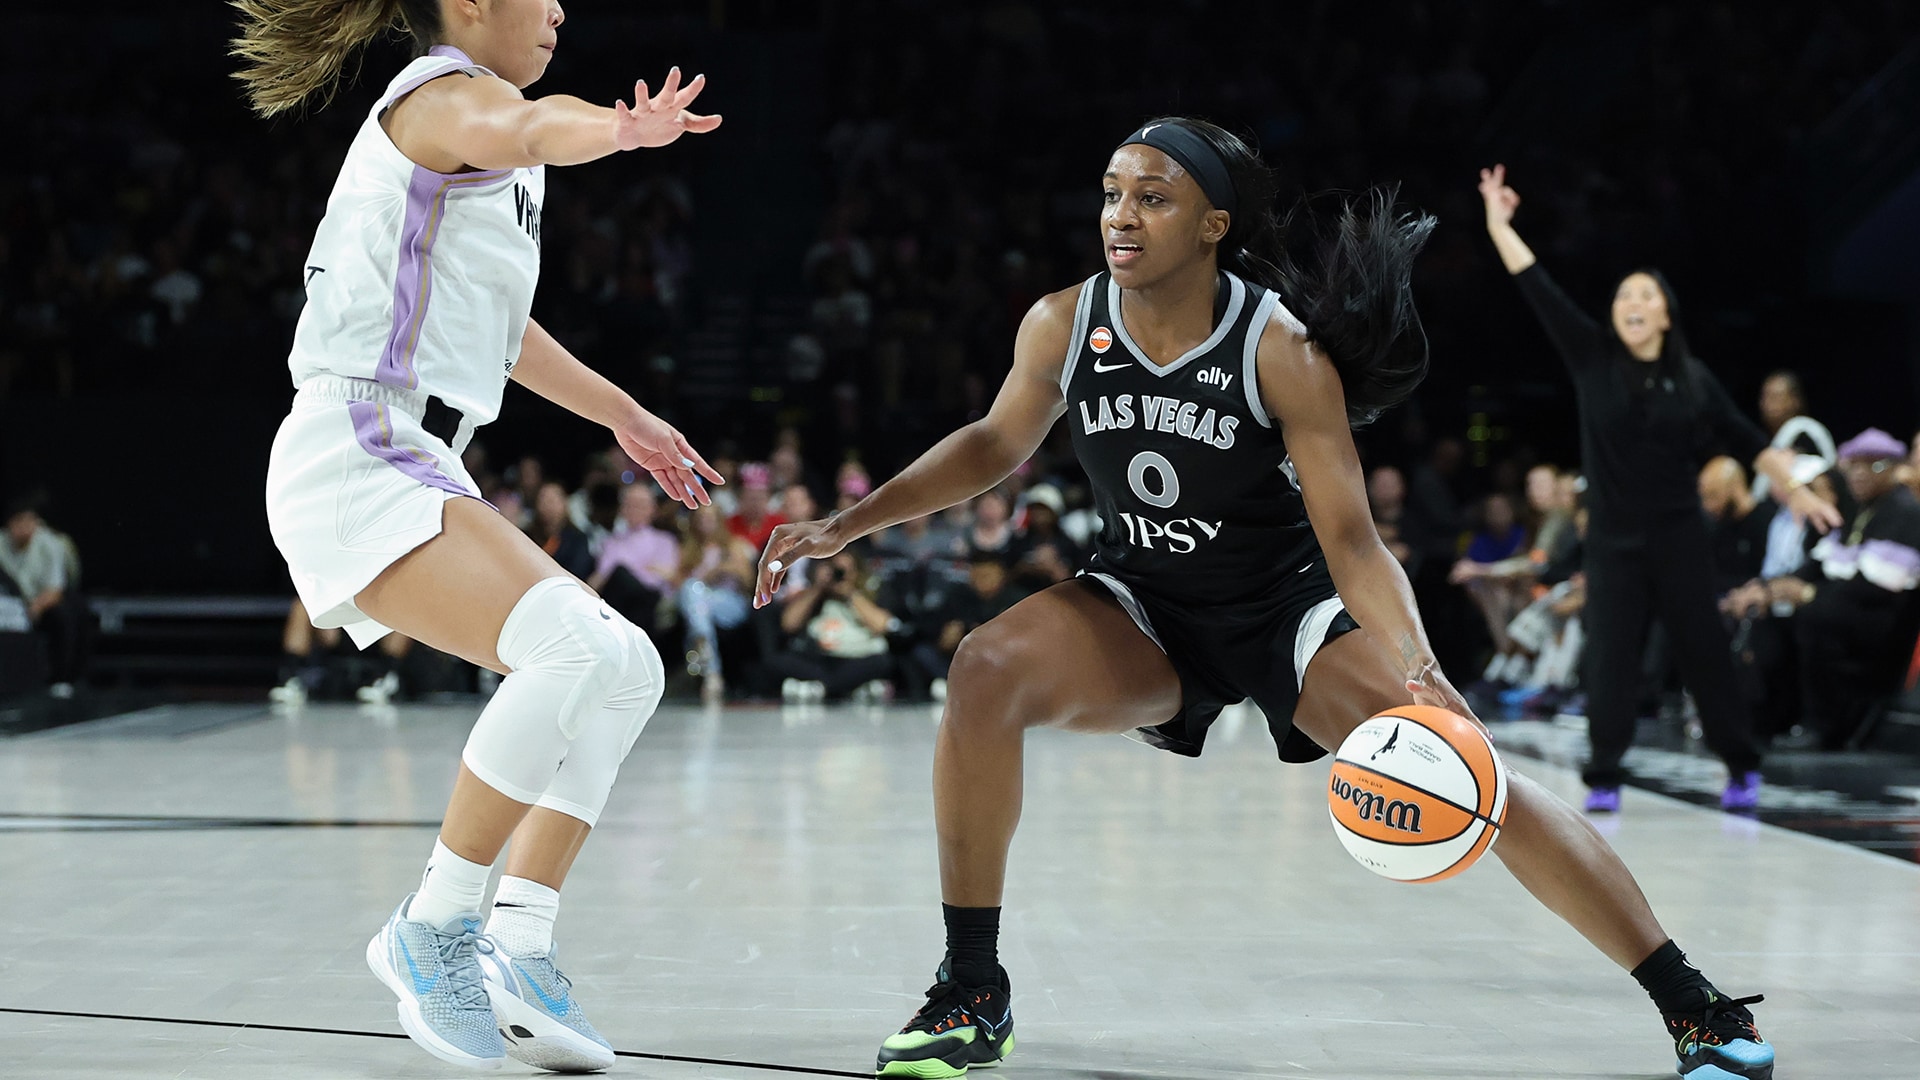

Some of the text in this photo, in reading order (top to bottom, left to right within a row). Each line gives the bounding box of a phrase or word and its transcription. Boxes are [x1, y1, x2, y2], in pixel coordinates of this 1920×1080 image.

[1196, 366, 1234, 391] ally
[1079, 394, 1240, 450] LAS VEGAS
[1127, 450, 1180, 509] 0
[1331, 772, 1424, 835] Wilson
